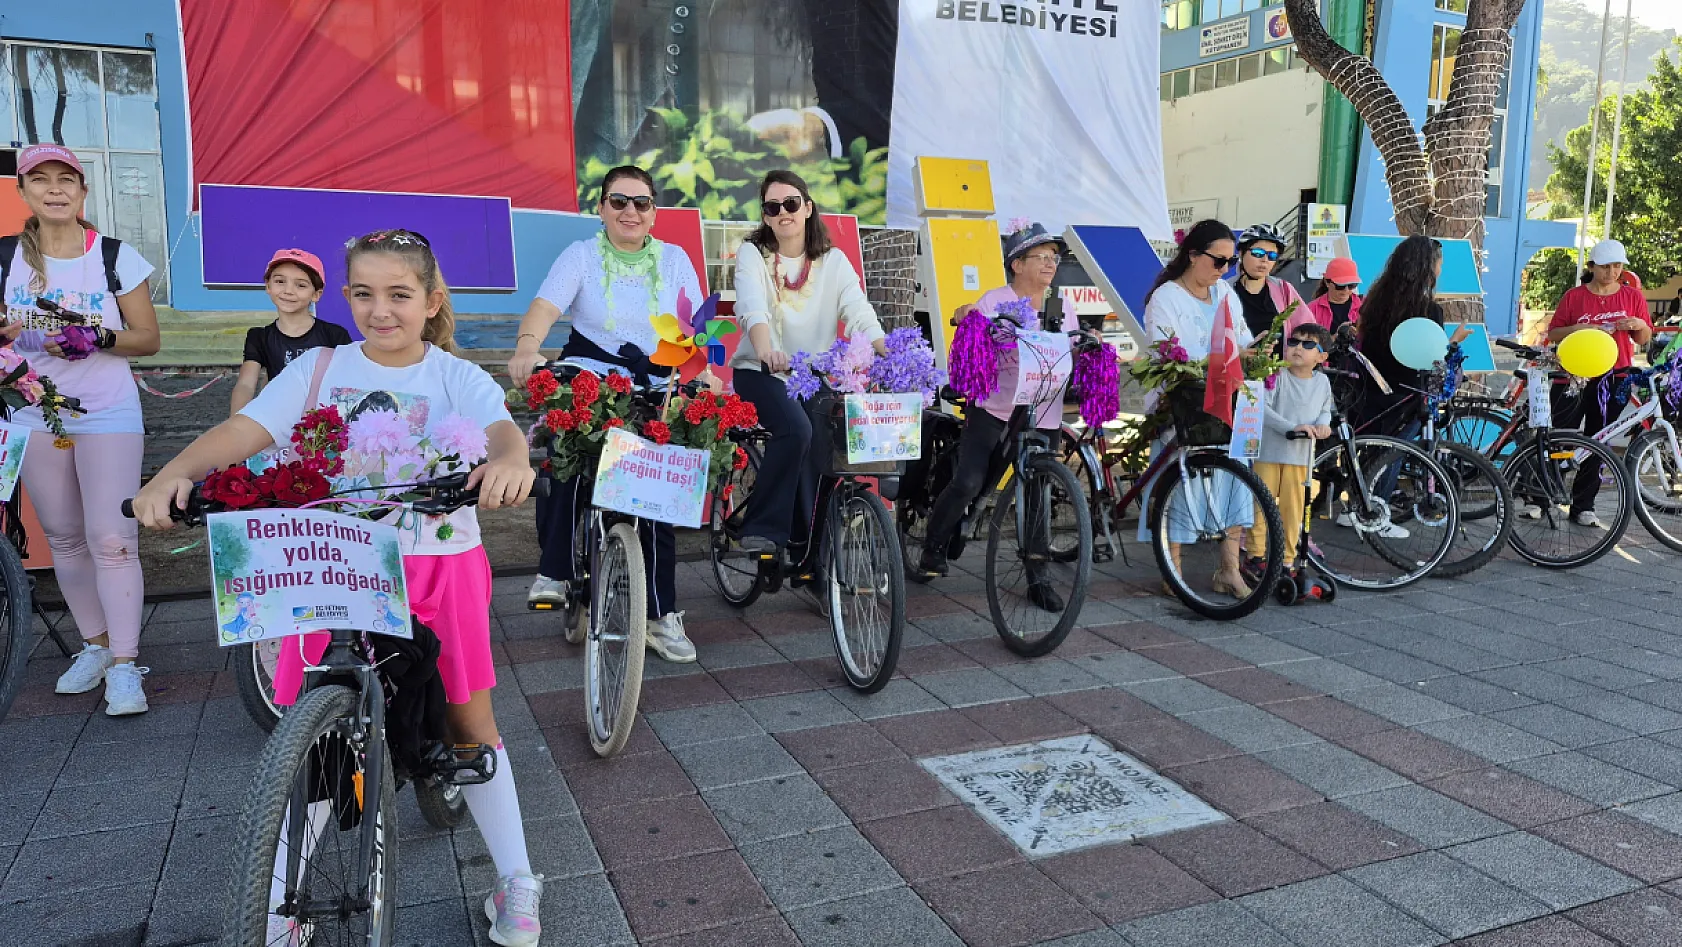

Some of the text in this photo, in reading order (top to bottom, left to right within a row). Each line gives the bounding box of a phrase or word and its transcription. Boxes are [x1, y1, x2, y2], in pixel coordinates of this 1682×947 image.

[935, 1, 1117, 38] BELEDİYESİ
[612, 434, 705, 472] Karbonu değil,
[666, 470, 699, 488] taşı!
[246, 518, 373, 546] Renklerimiz
[283, 541, 349, 567] yolda,
[322, 566, 399, 596] doğada!
